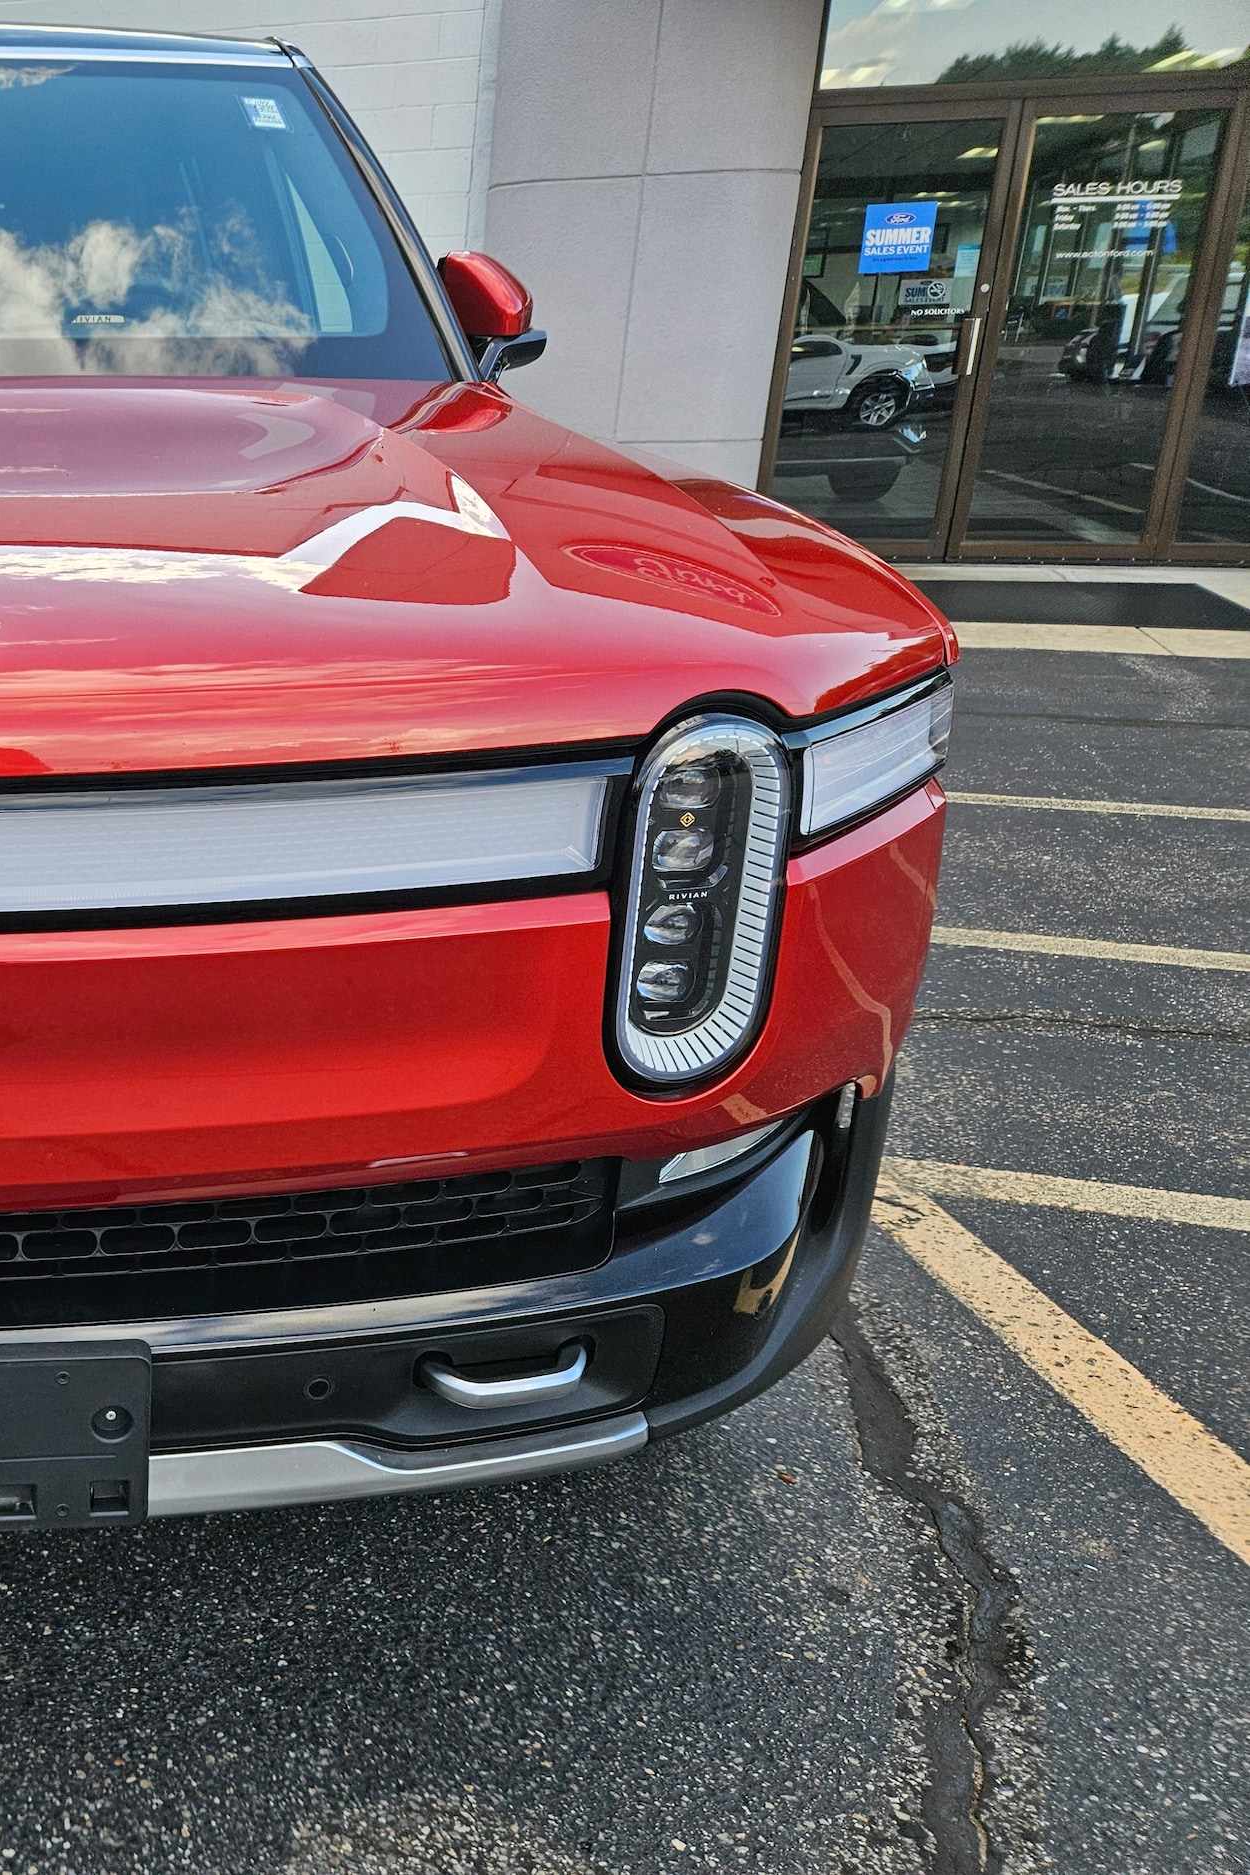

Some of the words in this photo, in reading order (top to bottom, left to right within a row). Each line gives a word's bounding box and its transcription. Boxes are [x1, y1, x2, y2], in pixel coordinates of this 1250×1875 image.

[1052, 181, 1112, 197] SALES
[1115, 179, 1183, 195] HOURS
[865, 226, 932, 247] SUMMER
[864, 245, 896, 257] SALES
[896, 244, 930, 255] EVENT
[1054, 248, 1155, 259] www.actonford.com
[910, 309, 924, 317] NO
[924, 307, 966, 316] SOLICITORS
[668, 891, 708, 901] RIVIAN
